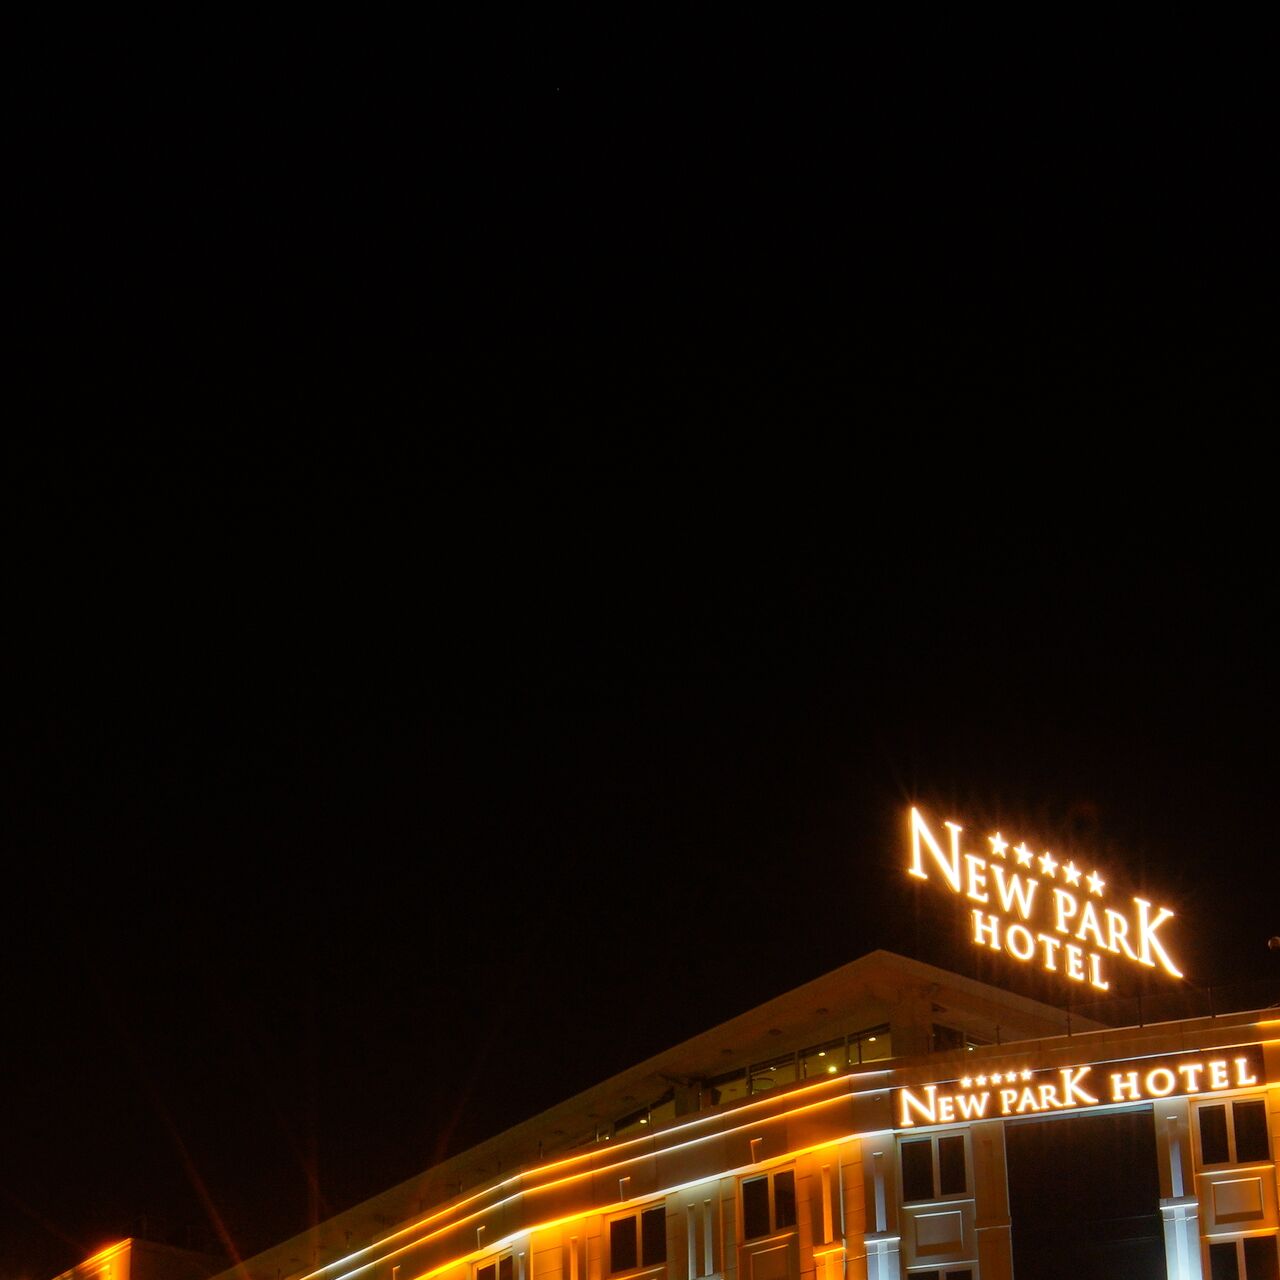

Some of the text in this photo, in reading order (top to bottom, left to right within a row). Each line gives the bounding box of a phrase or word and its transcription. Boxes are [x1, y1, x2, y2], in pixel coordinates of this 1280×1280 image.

[908, 806, 1183, 978] NEW PARK
[971, 909, 1109, 990] HOTEL
[900, 1058, 1256, 1126] NEW PARK HOTEL
